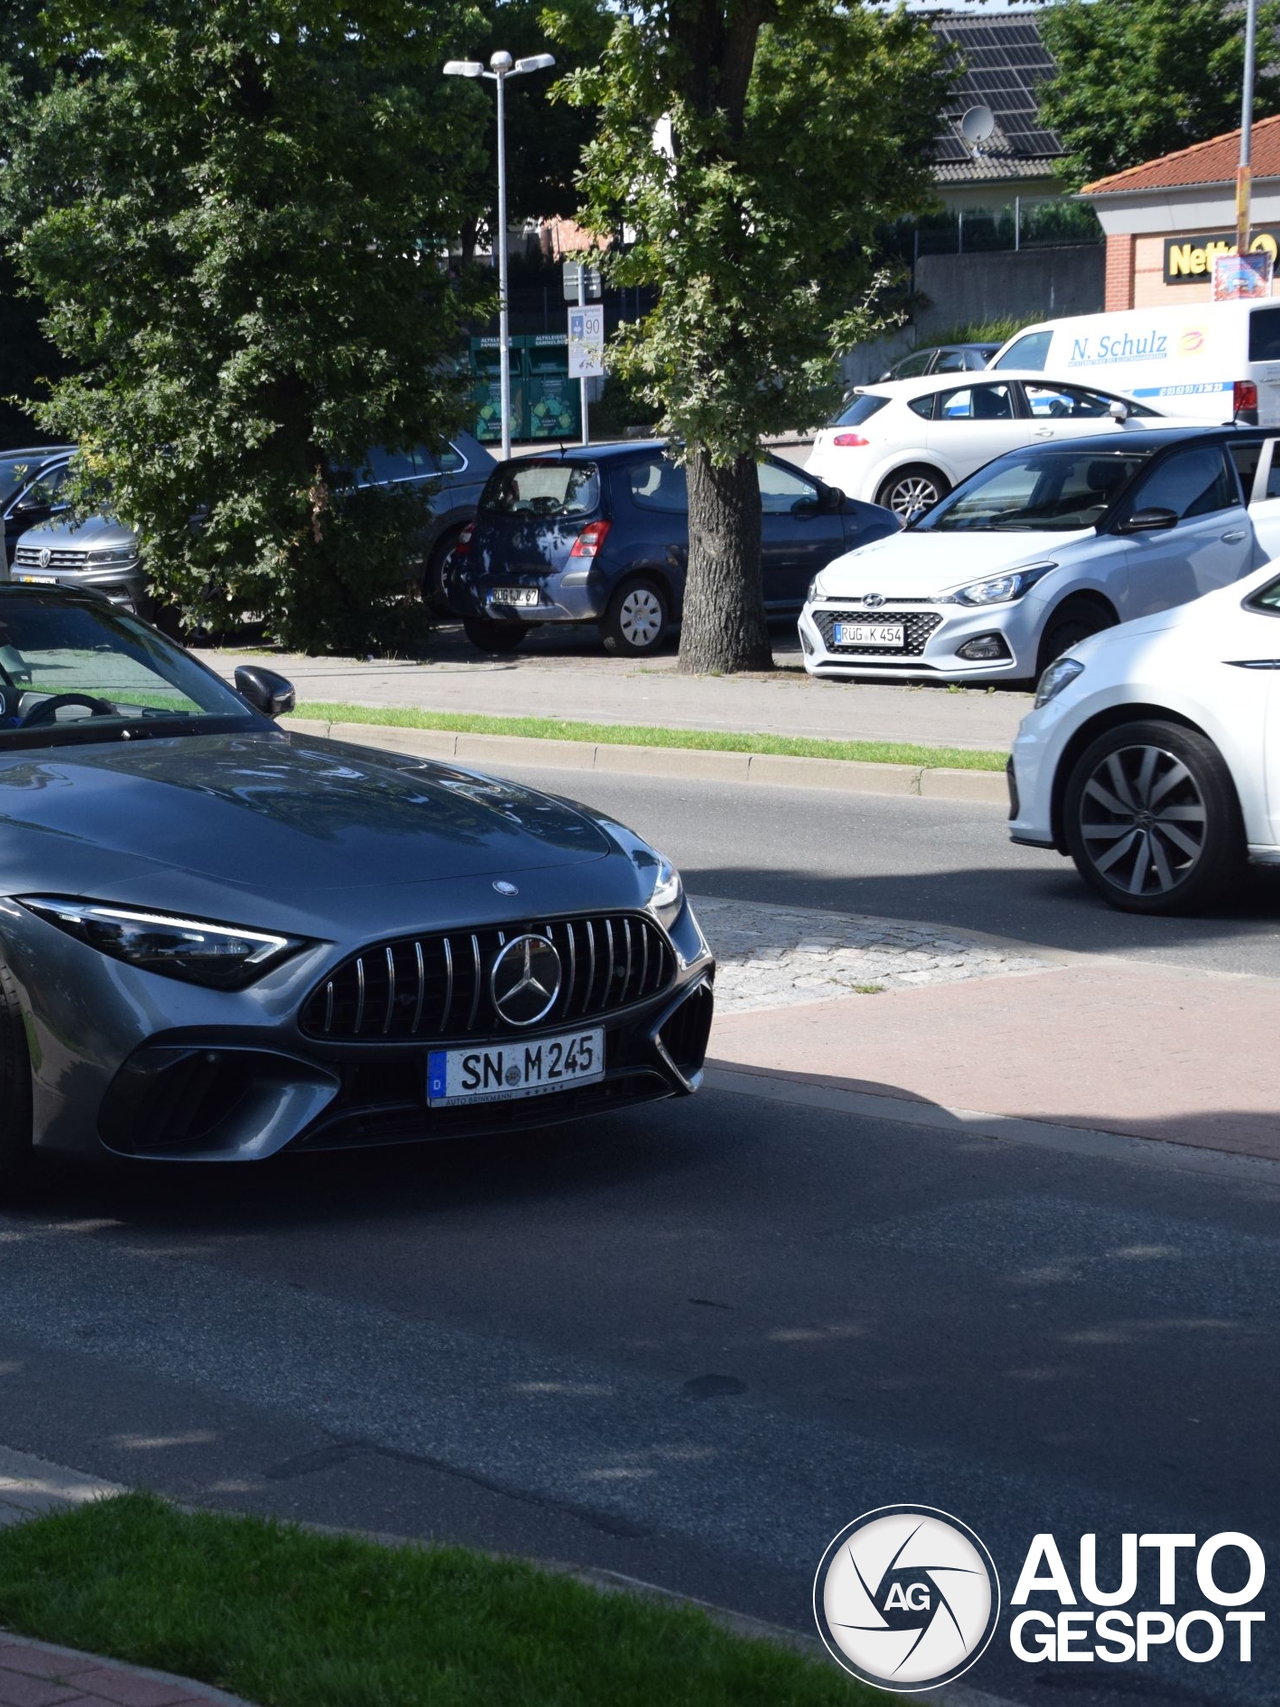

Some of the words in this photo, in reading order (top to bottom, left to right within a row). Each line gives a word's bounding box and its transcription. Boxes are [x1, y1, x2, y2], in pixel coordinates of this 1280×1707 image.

[1169, 241, 1238, 276] Nett
[586, 319, 600, 334] 90
[1071, 338, 1091, 360] N.
[1098, 330, 1167, 358] Schulz
[526, 590, 536, 602] 67
[841, 627, 862, 641] RÜG
[869, 628, 877, 640] K
[880, 628, 901, 641] 454
[433, 1079, 441, 1090] D
[461, 1051, 503, 1089] SN
[525, 1045, 542, 1082] M
[548, 1035, 593, 1079] 245
[445, 1096, 467, 1106] AUTO
[468, 1092, 513, 1105] BRINKMANN
